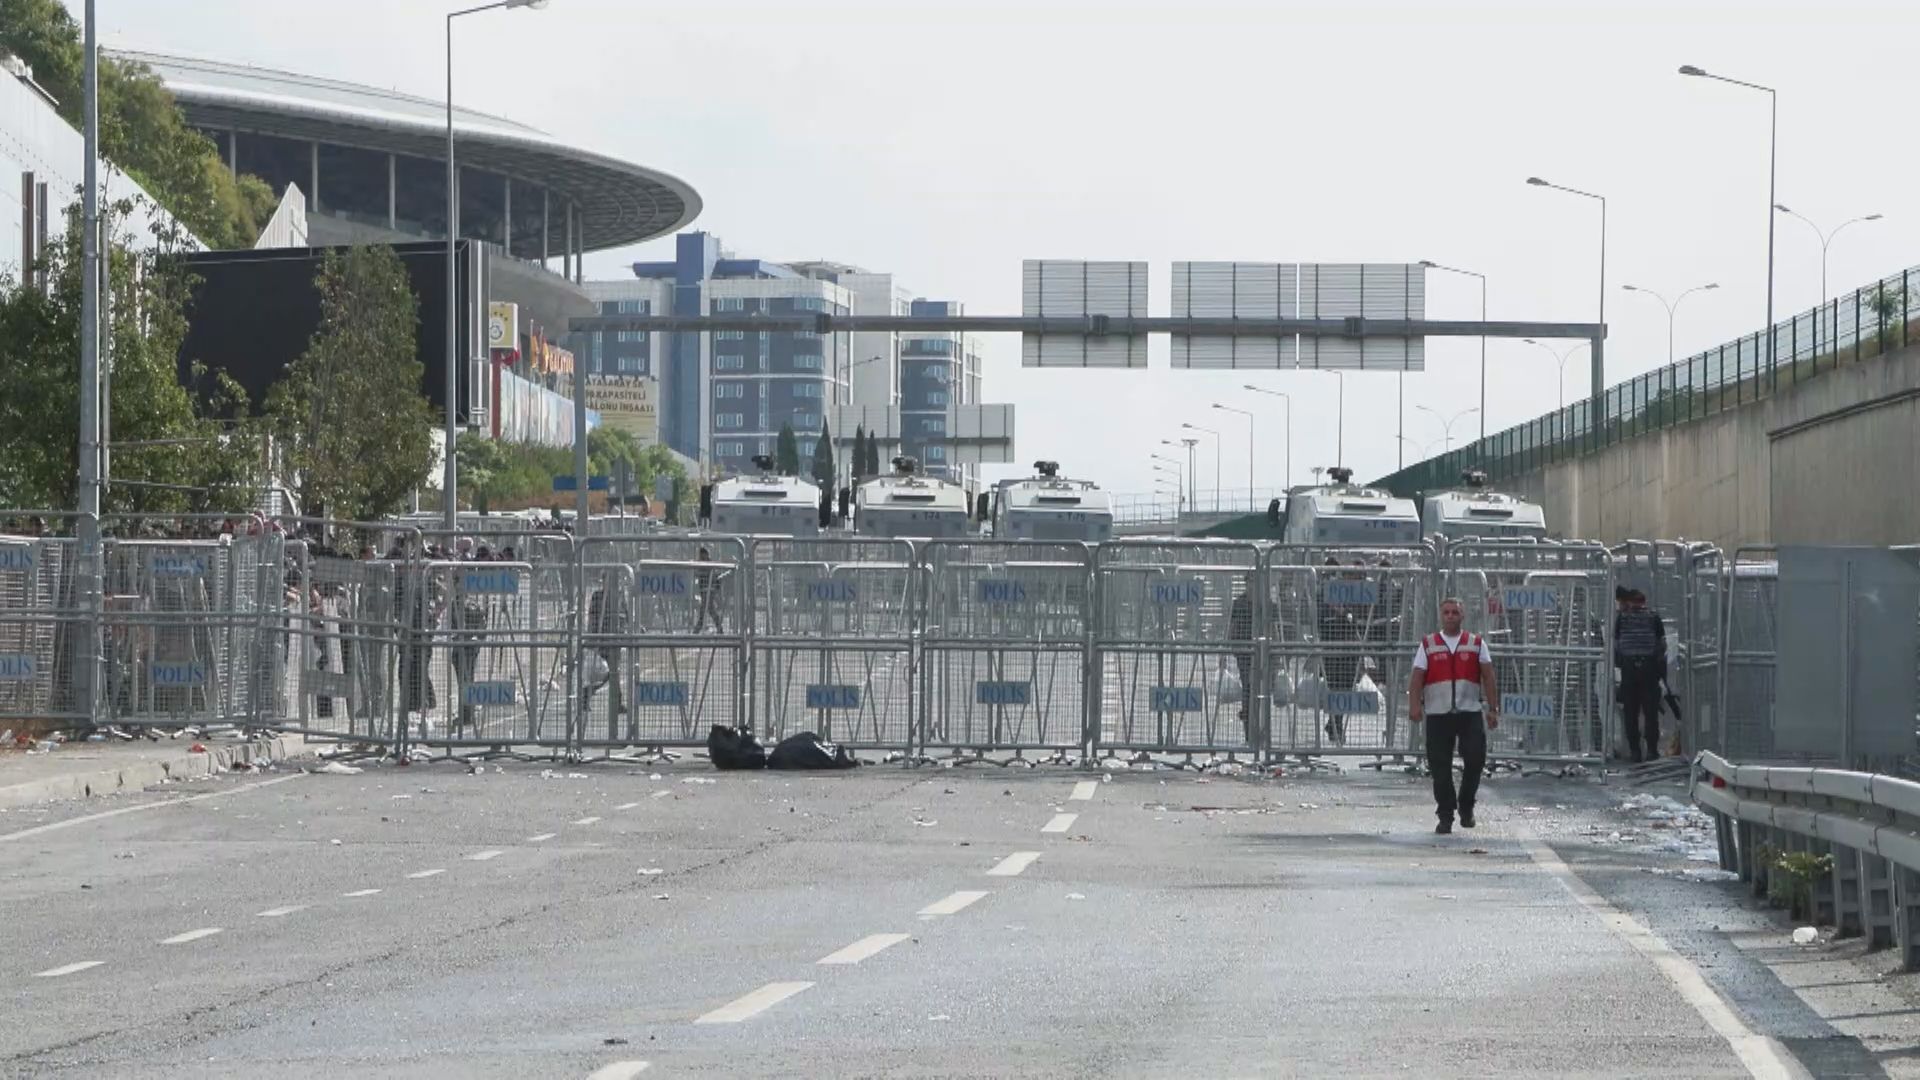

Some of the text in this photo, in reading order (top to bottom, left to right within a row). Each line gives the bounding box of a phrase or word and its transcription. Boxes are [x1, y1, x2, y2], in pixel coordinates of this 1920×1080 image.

[155, 556, 205, 573] POLİS
[466, 571, 516, 590] POLİS
[641, 573, 684, 593] POLİS
[808, 580, 856, 599] POLİS
[984, 580, 1025, 599] POLİS
[1156, 583, 1198, 600] POLİS
[1328, 582, 1372, 601] POLİS
[1508, 589, 1556, 608] POLİS
[153, 663, 204, 681] POLİS
[468, 684, 510, 703] POLİS
[640, 683, 684, 702] POLİS
[810, 687, 857, 706] POLİS
[982, 683, 1024, 700] POLİS
[1156, 691, 1198, 709] POLİS
[1328, 692, 1370, 711] POLİS
[1504, 696, 1550, 715] POLİS
